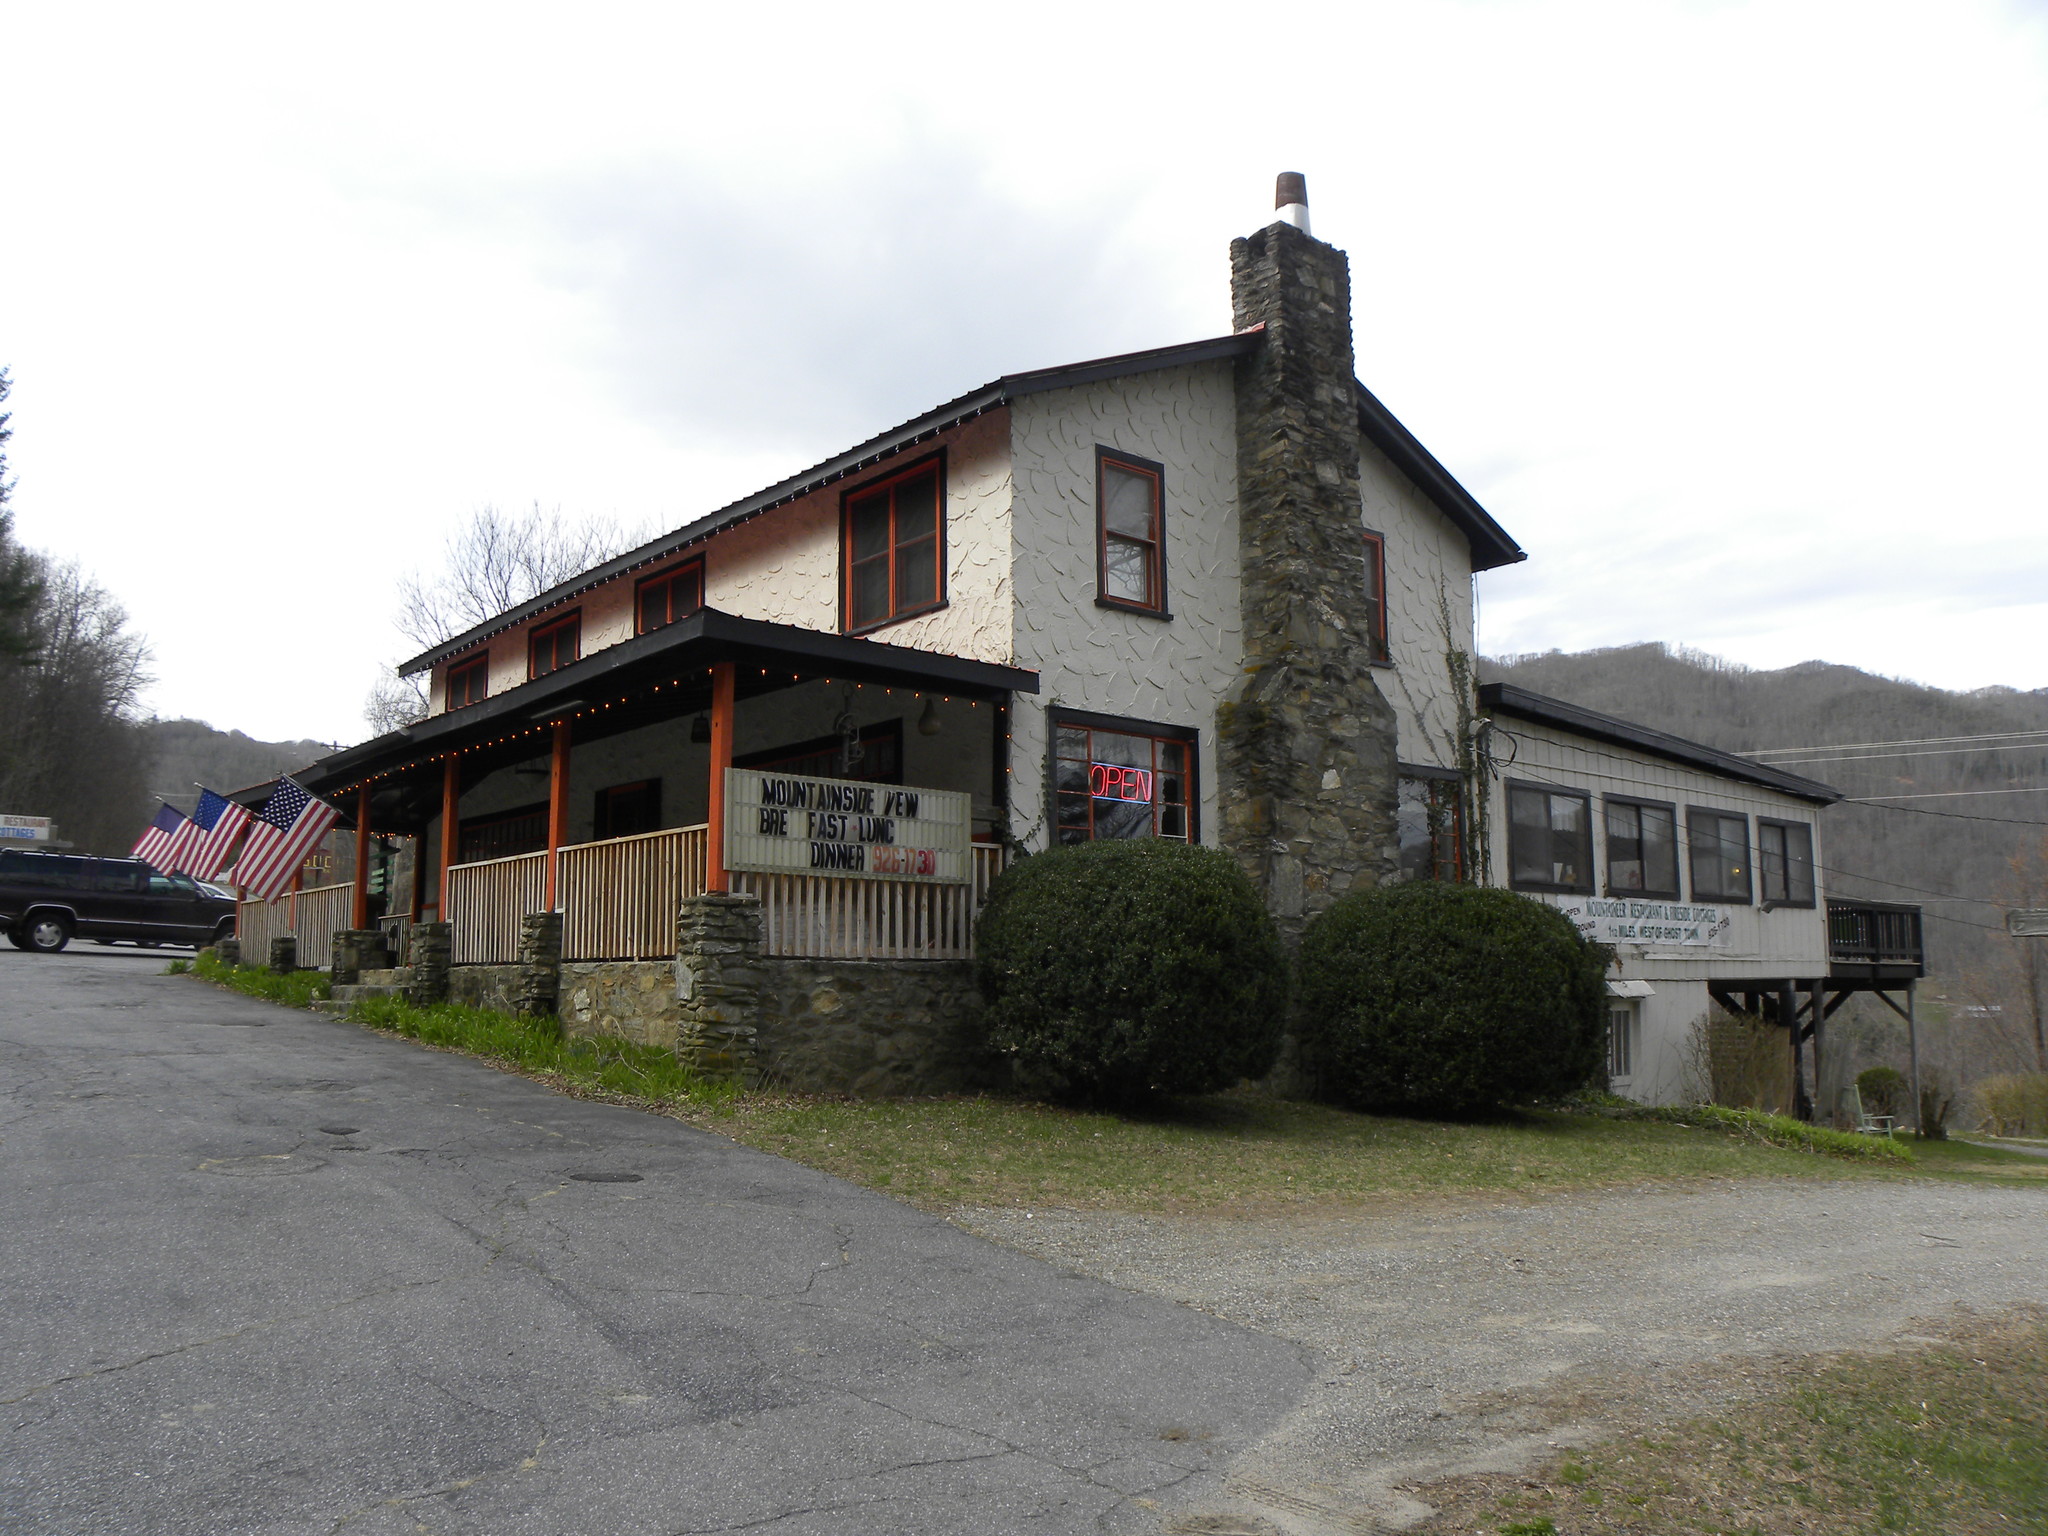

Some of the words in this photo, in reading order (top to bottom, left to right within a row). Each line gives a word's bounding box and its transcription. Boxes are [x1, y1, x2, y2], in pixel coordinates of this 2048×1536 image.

[762, 779, 874, 813] MOUNTAINSIDE
[1091, 765, 1151, 802] OPEN
[808, 812, 848, 841] FAST
[858, 817, 894, 844] LUNC
[811, 842, 865, 871] DINNER
[873, 846, 936, 876] 926-1730
[1630, 903, 1662, 920] RESTAURANT
